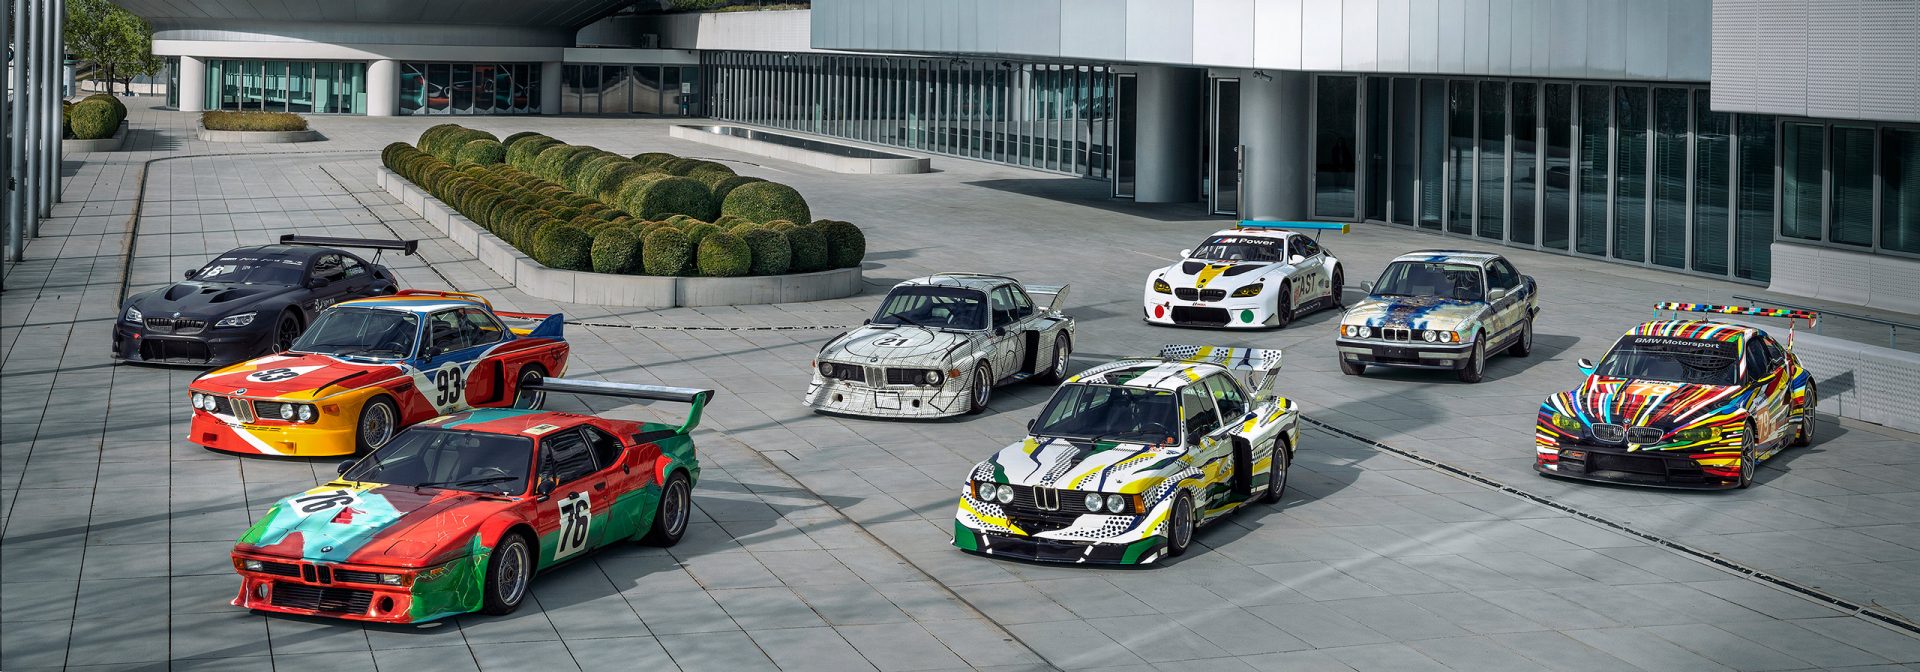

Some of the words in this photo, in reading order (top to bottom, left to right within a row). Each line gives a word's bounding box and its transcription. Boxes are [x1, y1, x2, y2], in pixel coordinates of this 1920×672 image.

[1239, 238, 1275, 246] Power
[878, 338, 909, 346] 21
[1662, 339, 1720, 349] Motorsport
[252, 368, 299, 381] 93
[437, 367, 461, 406] 93
[1631, 384, 1670, 396] 79
[1758, 411, 1769, 439] 79
[295, 490, 354, 513] 76
[559, 499, 589, 553] 76
